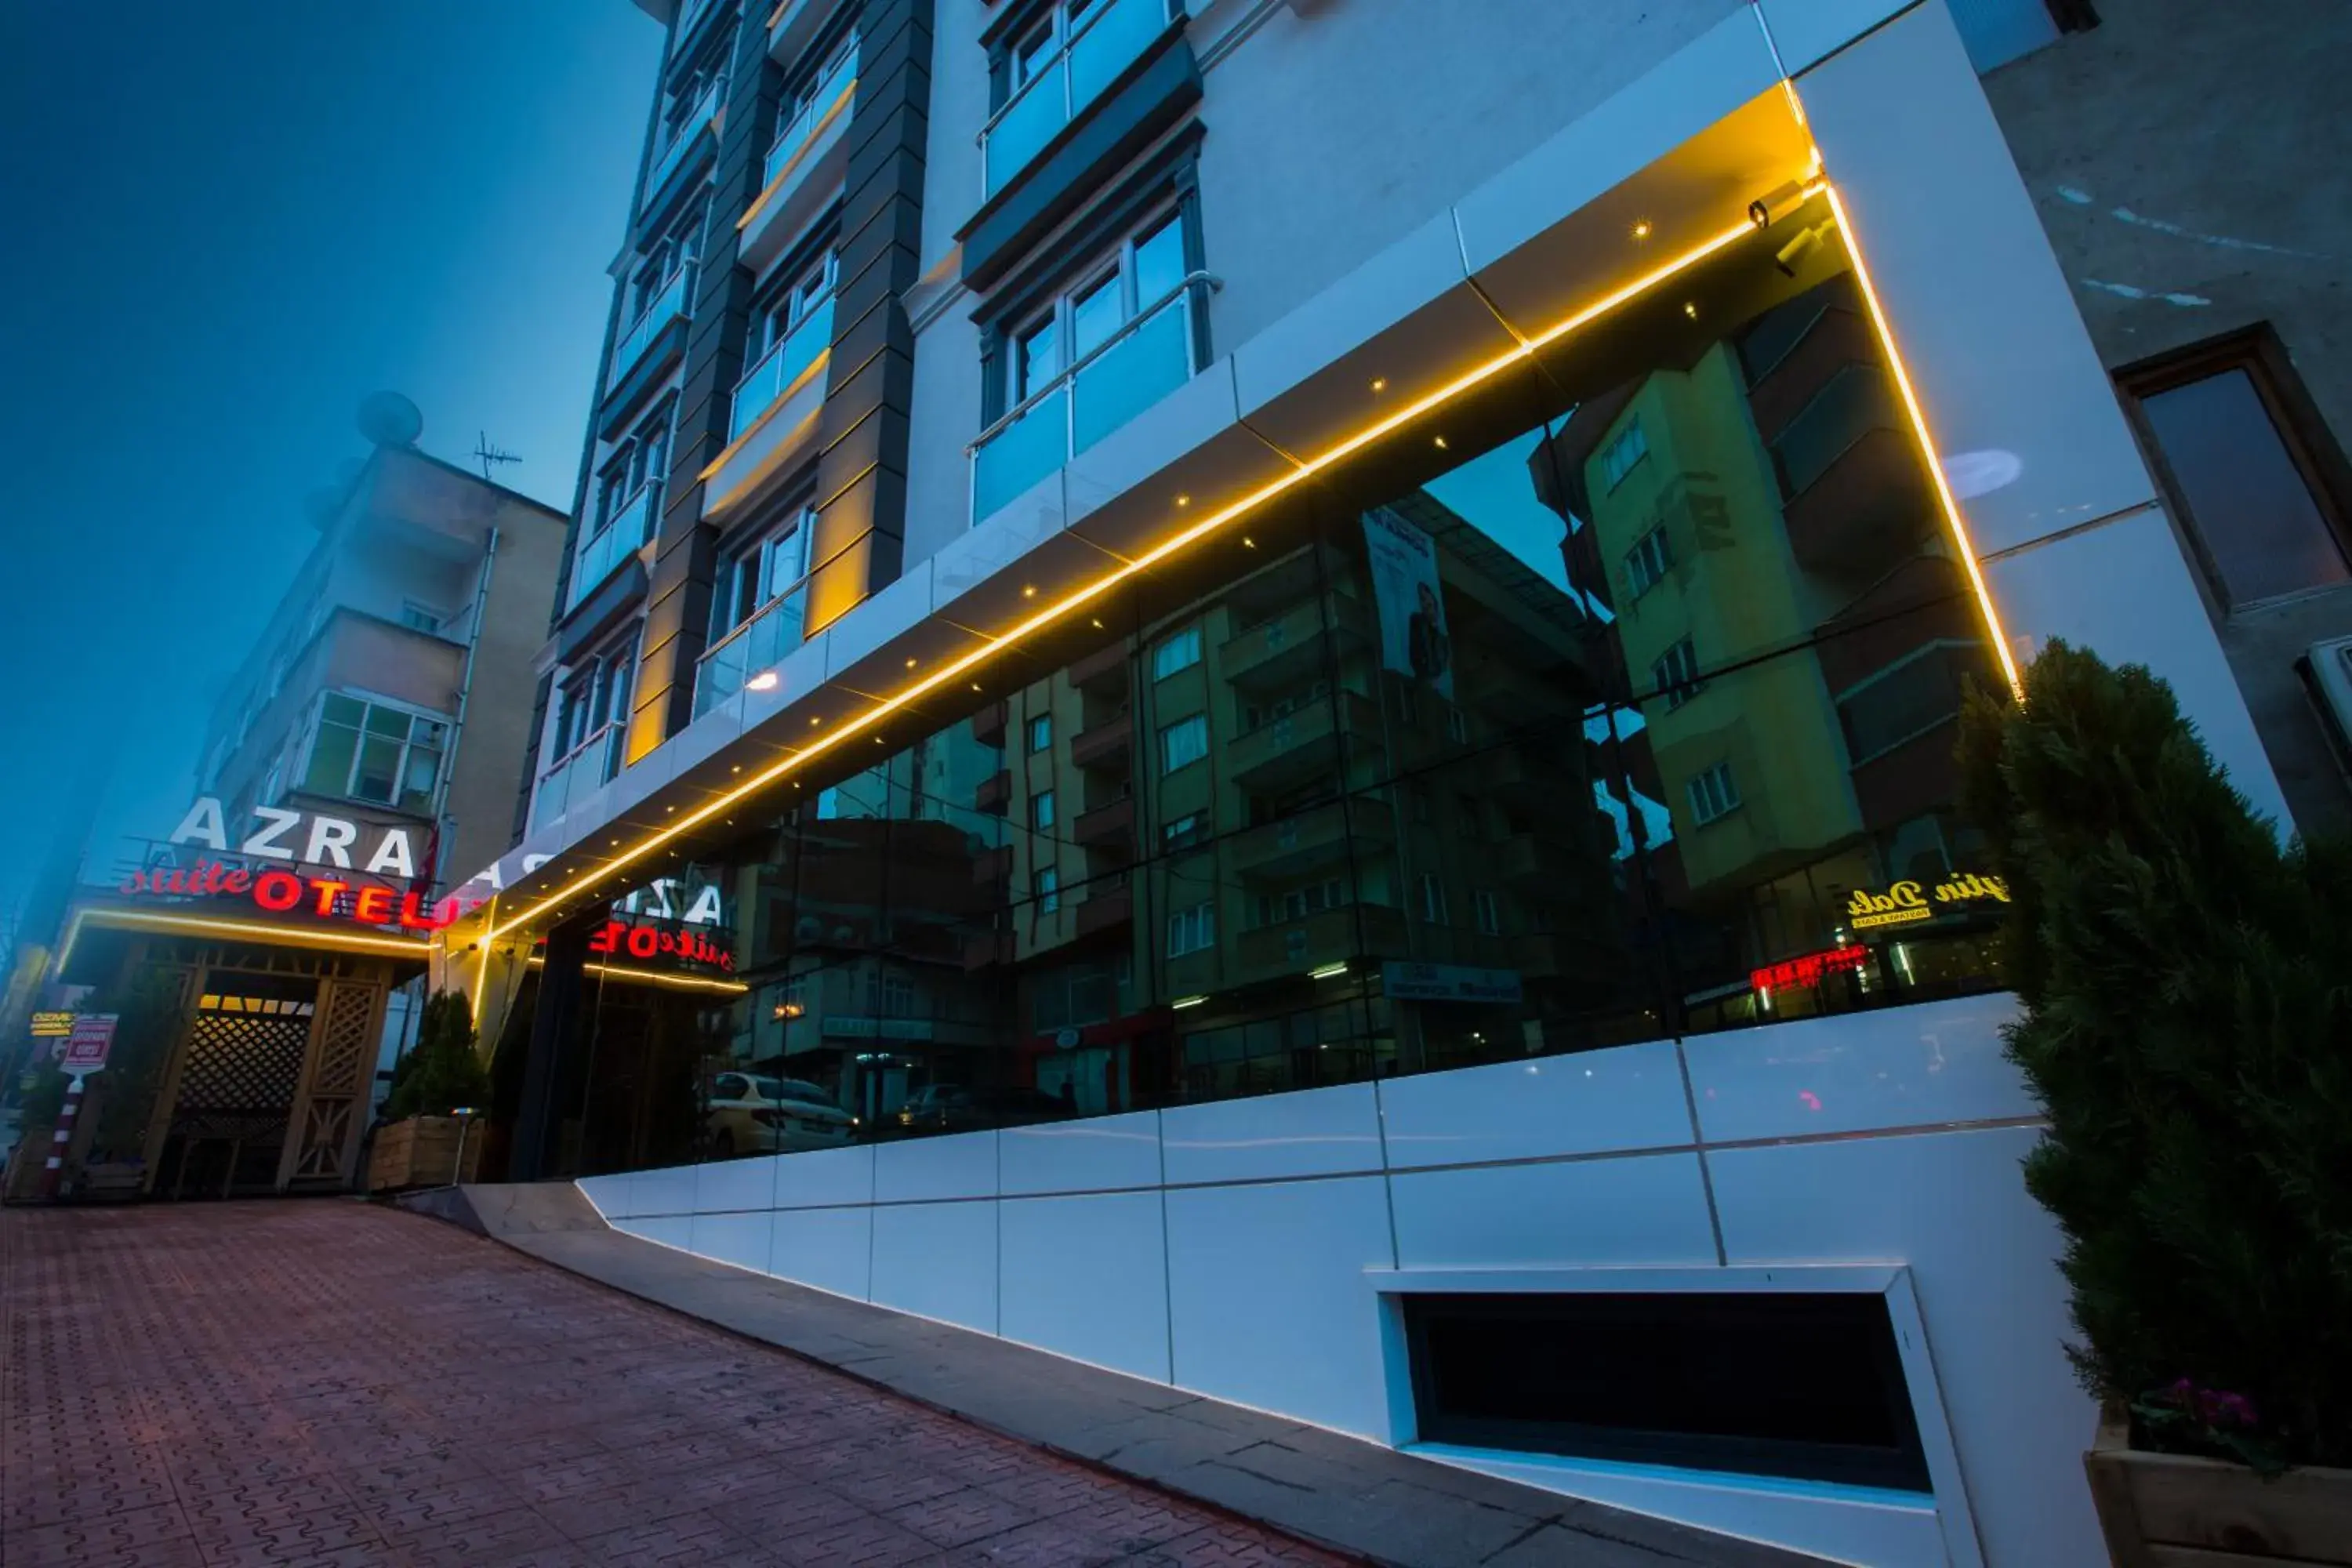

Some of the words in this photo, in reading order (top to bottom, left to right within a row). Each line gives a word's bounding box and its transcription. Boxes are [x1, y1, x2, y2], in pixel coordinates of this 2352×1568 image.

[169, 797, 415, 878] AZRA
[120, 858, 252, 895] suite
[253, 871, 439, 931] OTEL
